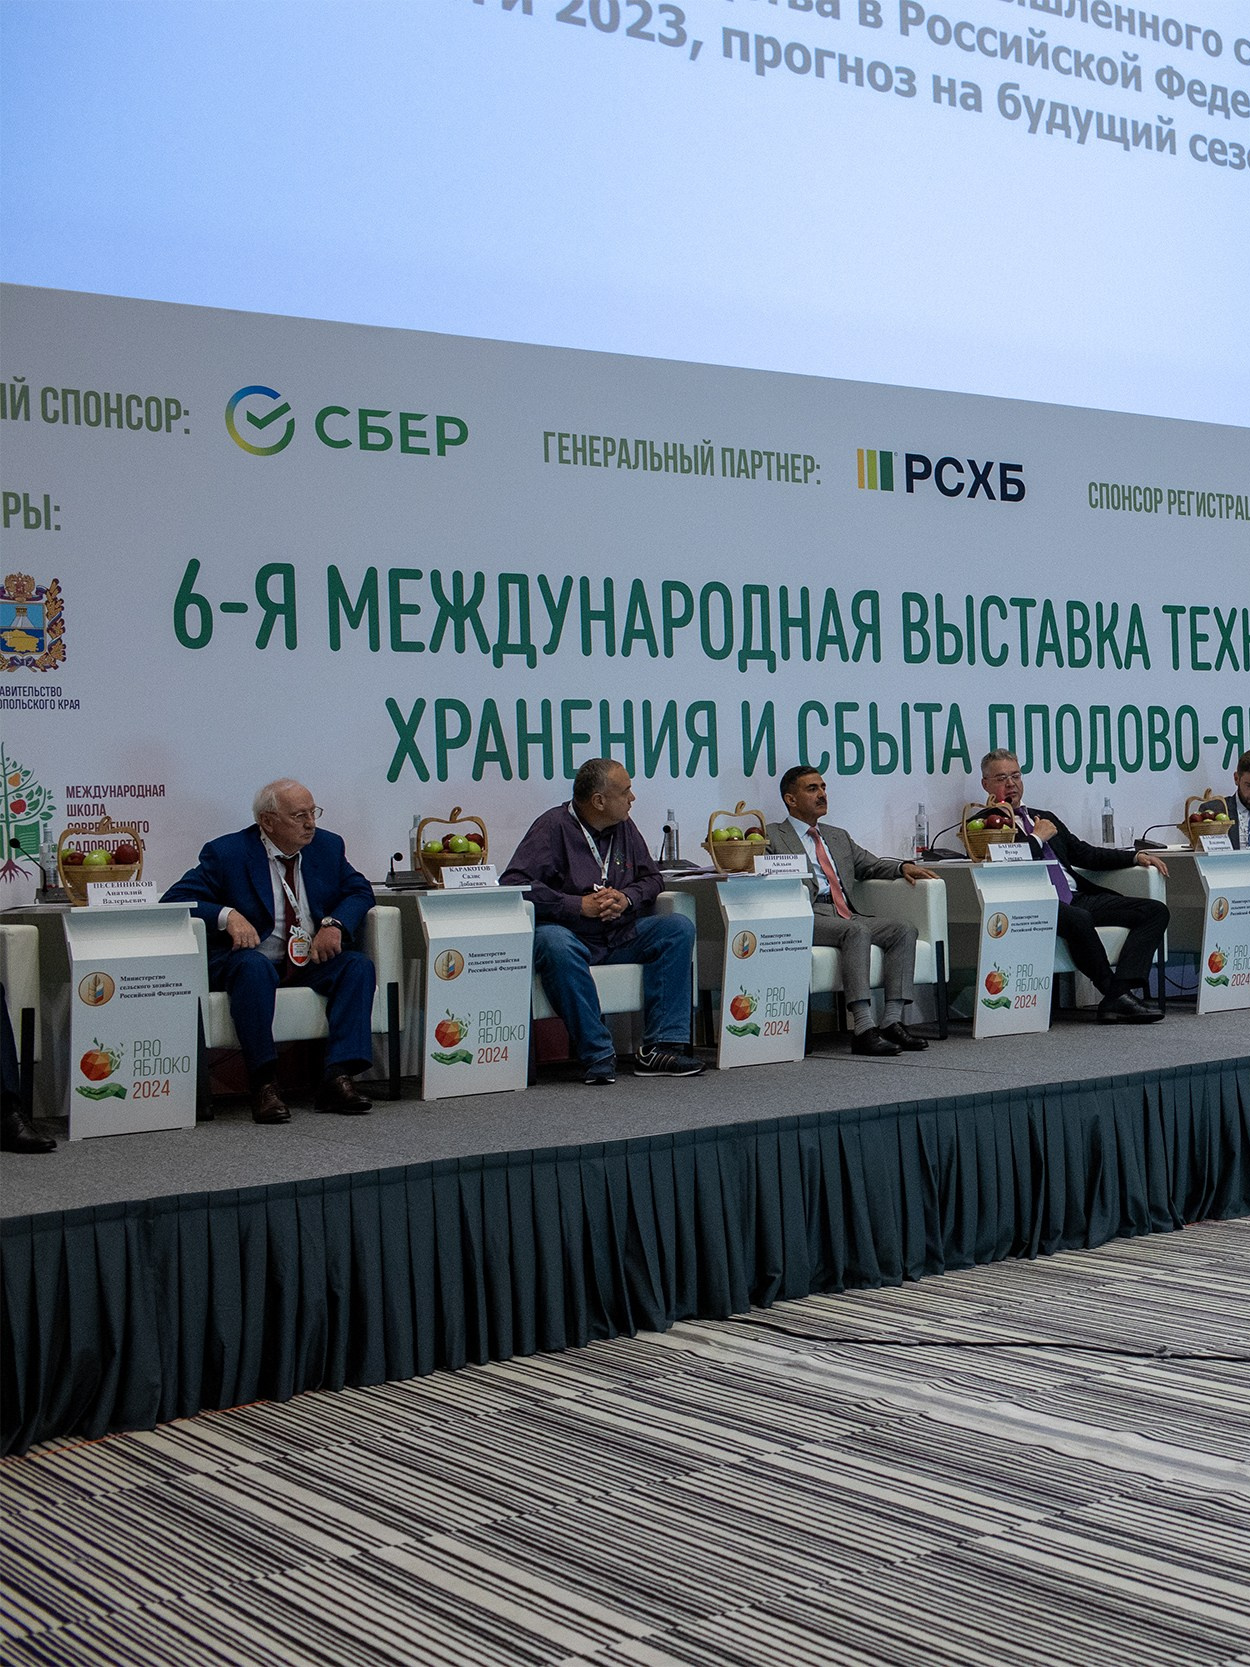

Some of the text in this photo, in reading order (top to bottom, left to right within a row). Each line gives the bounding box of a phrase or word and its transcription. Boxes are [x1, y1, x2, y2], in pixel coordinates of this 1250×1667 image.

[899, 0, 1144, 92] Российской
[722, 27, 917, 98] прогноз
[932, 73, 983, 112] на
[997, 82, 1177, 156] будущий
[40, 386, 190, 435] СПОНСОР:
[314, 405, 470, 456] СБЕР
[543, 430, 822, 486] ГЕНЕРАЛЬНЫЙ ПАРТНЕР:
[904, 452, 1027, 503] РСХБ
[1088, 481, 1164, 514] СПОНСОР
[172, 558, 298, 651] 6-Я
[326, 564, 880, 674] МЕЖДУНАРОДНАЯ
[900, 591, 1152, 671] ВЫСТАВКА
[0, 686, 62, 698] АВИТЕЛЬСТВО
[58, 699, 80, 710] КРАЯ
[385, 698, 719, 783] ХРАНЕНИЯ
[741, 700, 777, 778] И
[797, 701, 973, 776] СБЫТА
[66, 784, 165, 799] МЕЖДУНАРОДНАЯ
[66, 804, 107, 817] ШКОЛА
[1233, 945, 1248, 957] PRO
[120, 974, 166, 982] Министерство
[1016, 964, 1034, 978] PRO
[1015, 976, 1050, 992] ЯБЛОКО
[1231, 973, 1250, 987] 2024
[119, 989, 192, 999] Российской Федерации
[766, 987, 786, 1002] PRO
[1014, 994, 1037, 1009] 2024
[764, 1000, 804, 1017] ЯБЛОКО
[478, 1010, 502, 1027] PRO
[478, 1024, 526, 1044] ЯБЛОКО
[764, 1020, 790, 1036] 2024
[133, 1039, 161, 1057] PRO
[477, 1047, 509, 1065] 2024
[132, 1055, 191, 1077] ЯБЛОКО
[132, 1079, 171, 1100] 2024
